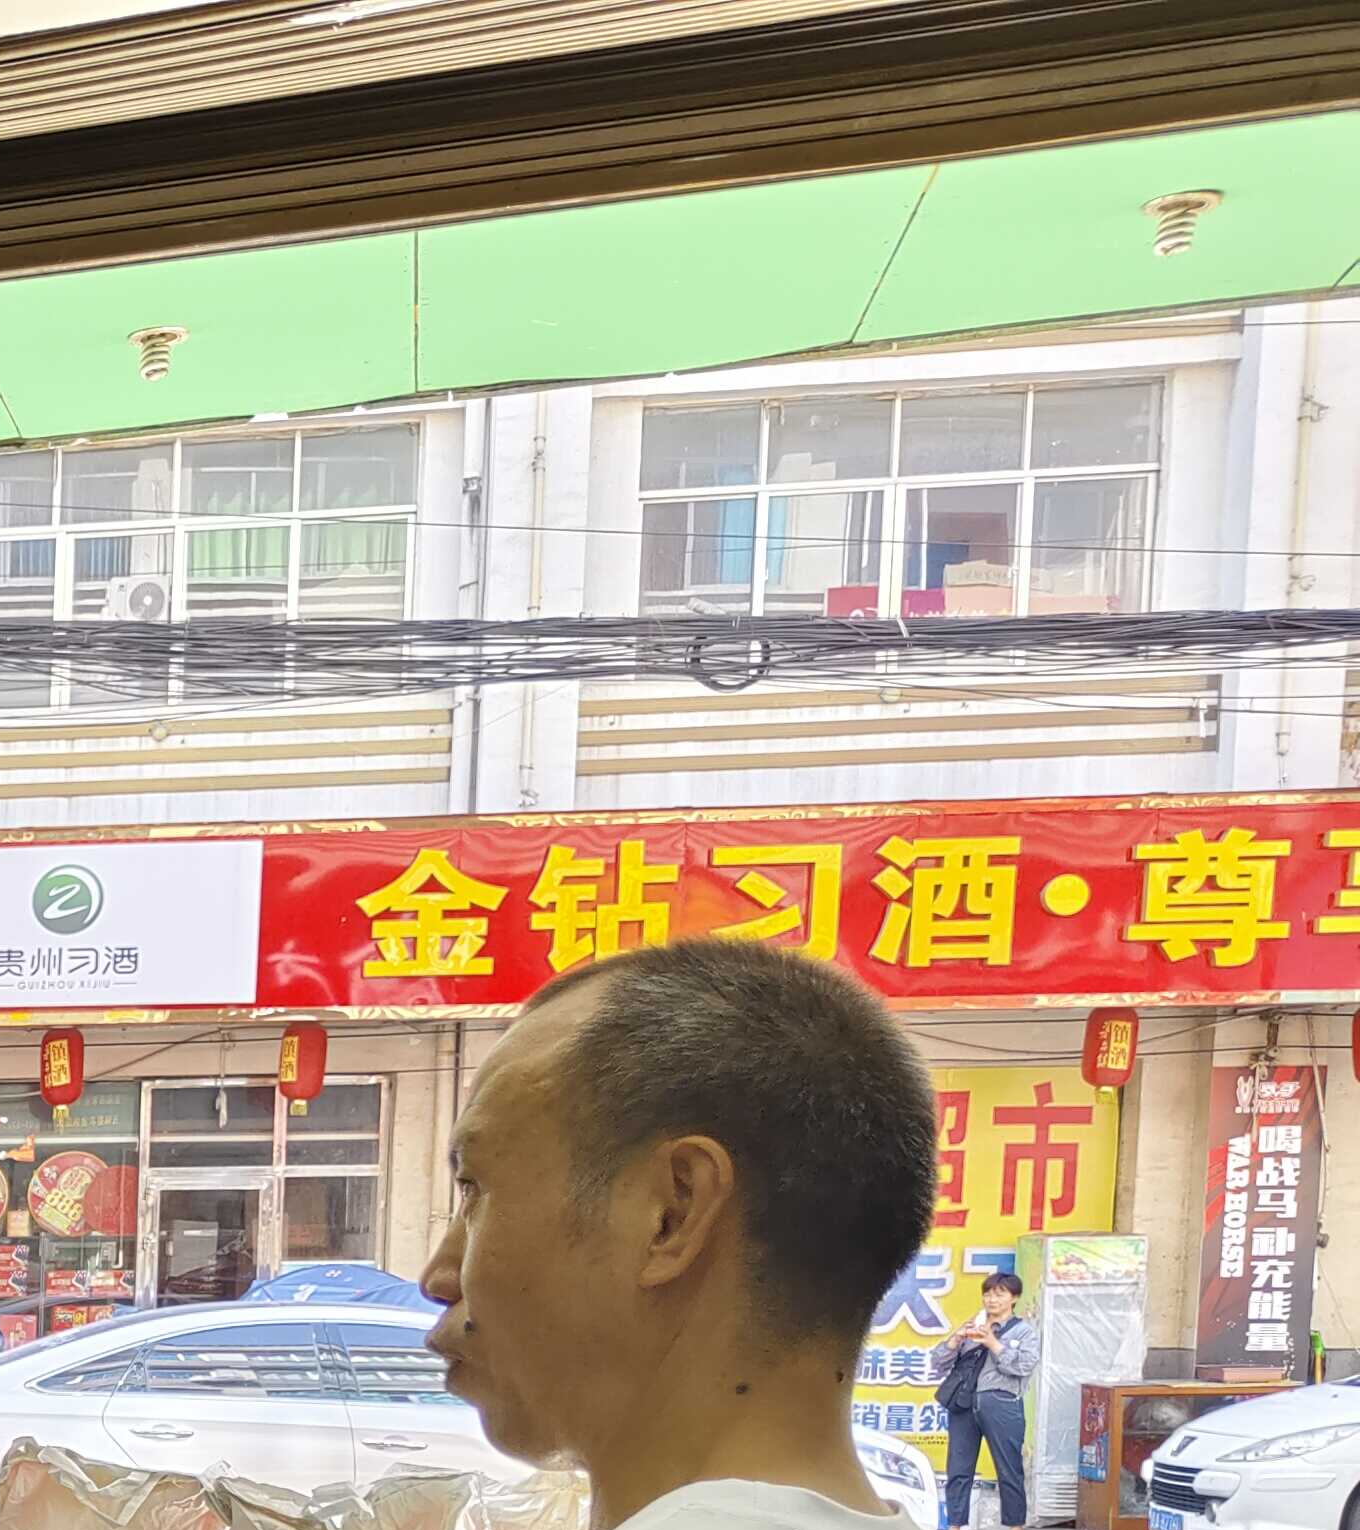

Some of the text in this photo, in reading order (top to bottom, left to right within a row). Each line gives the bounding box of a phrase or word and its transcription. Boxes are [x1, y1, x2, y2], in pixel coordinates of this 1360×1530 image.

[16, 977, 112, 992] GUIZHOU XIJIU
[1220, 1131, 1252, 1279] WAR HORSE
[1244, 1124, 1302, 1353] 喝战马 补充能量
